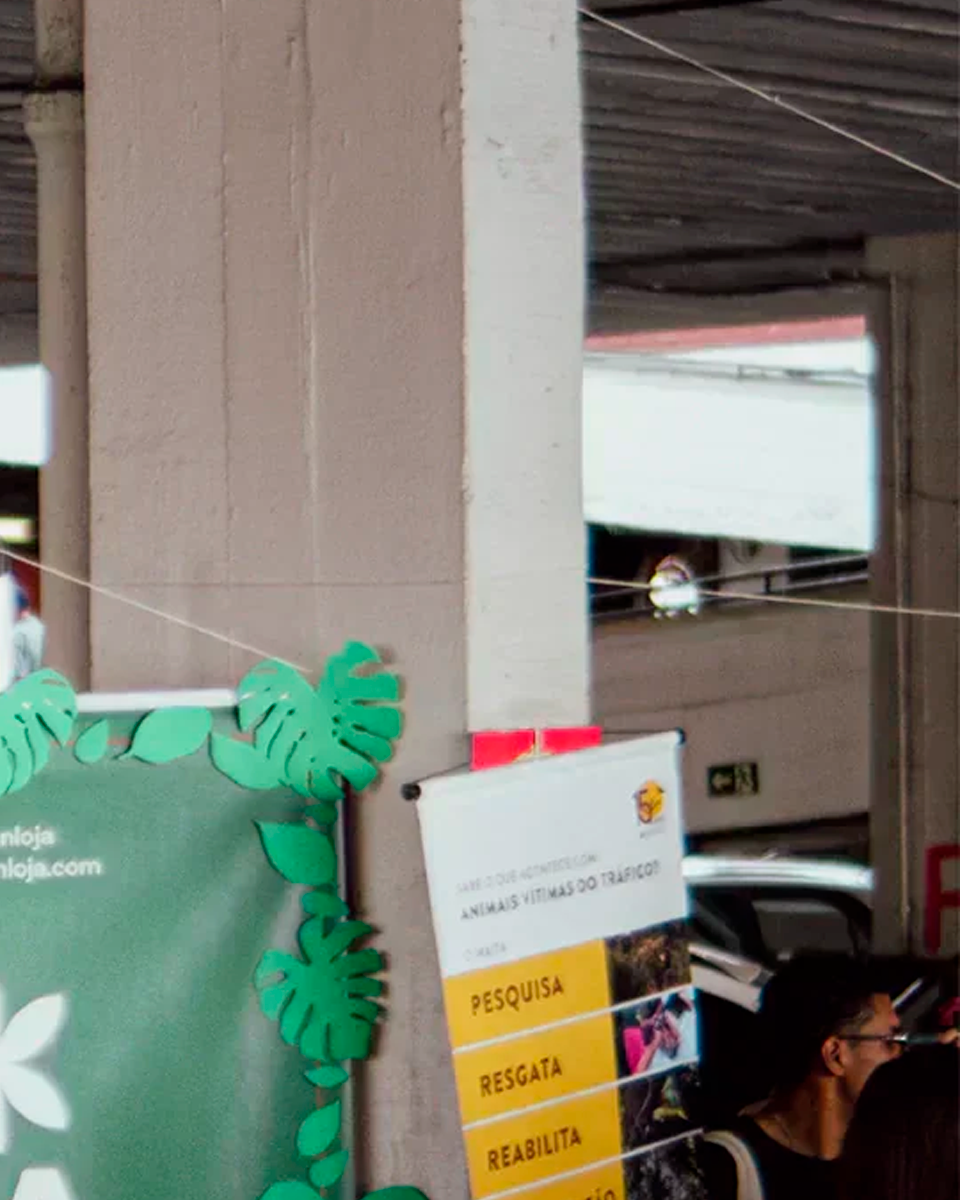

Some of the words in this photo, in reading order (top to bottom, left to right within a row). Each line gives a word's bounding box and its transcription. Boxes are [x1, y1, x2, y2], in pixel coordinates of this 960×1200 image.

[461, 893, 519, 919] ANIMAIS
[577, 875, 597, 893] DO
[470, 975, 564, 1016] PESQUISA
[479, 1057, 563, 1097] RESGATA
[487, 1126, 582, 1172] REABILITA
